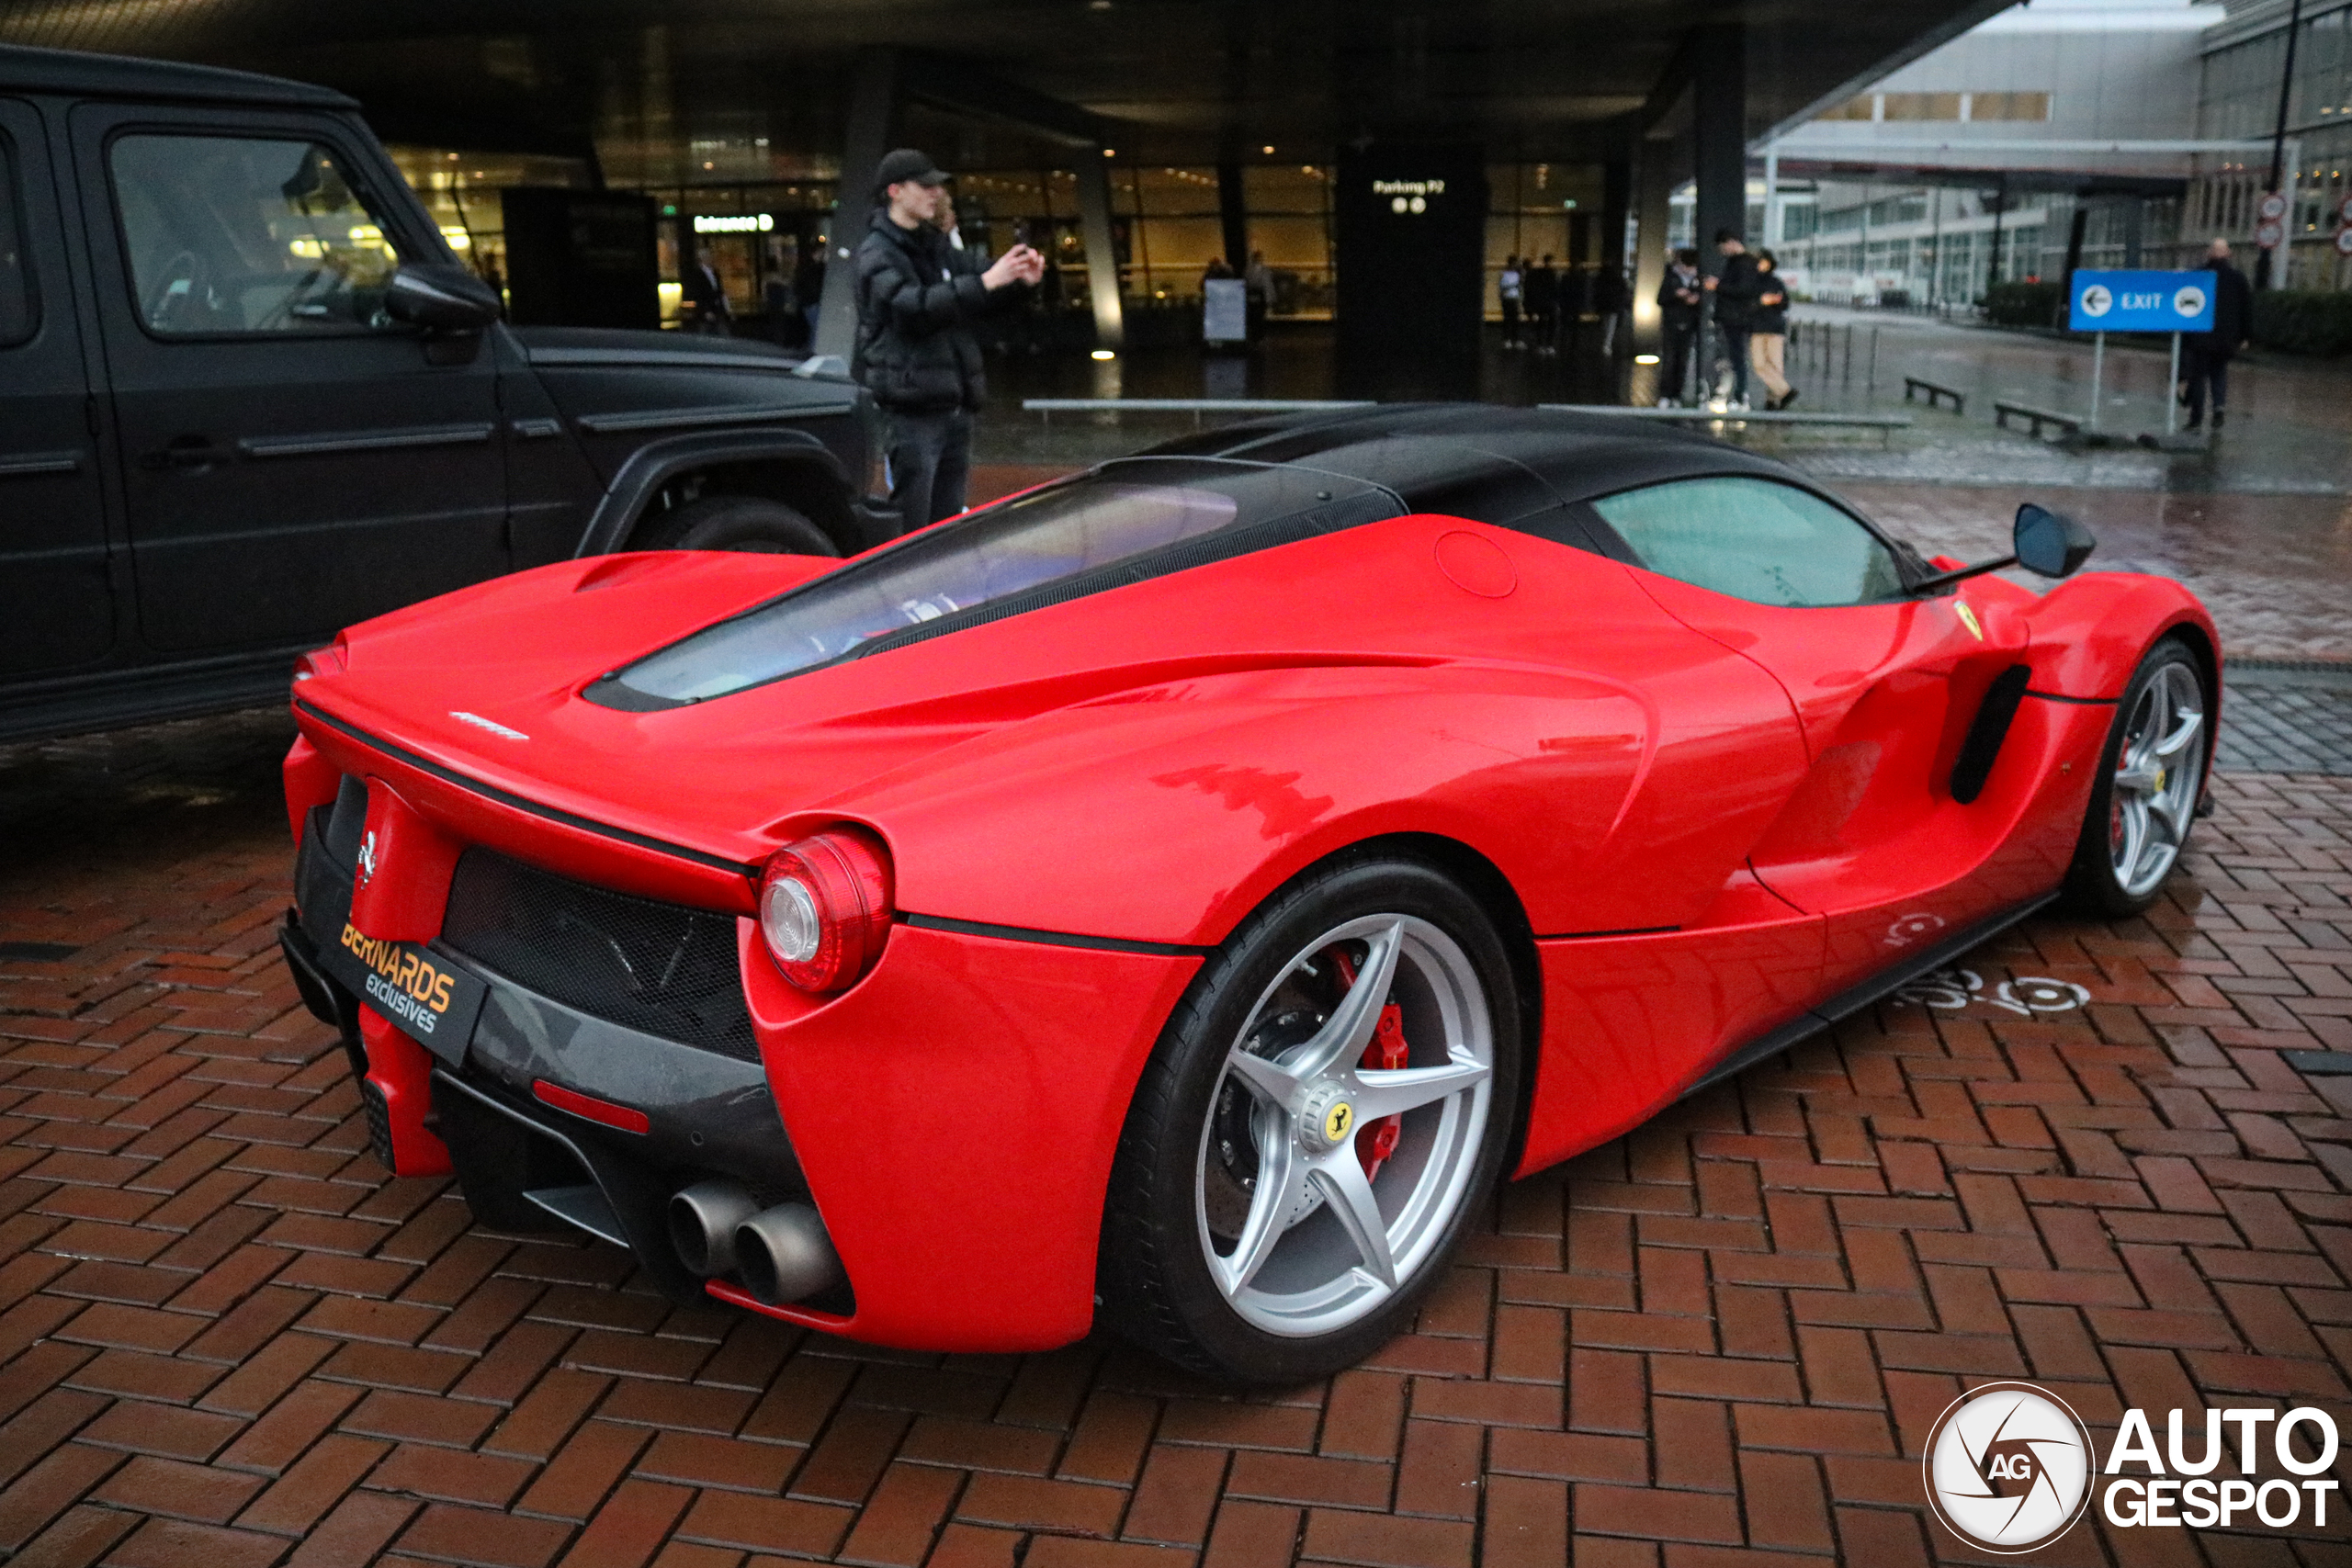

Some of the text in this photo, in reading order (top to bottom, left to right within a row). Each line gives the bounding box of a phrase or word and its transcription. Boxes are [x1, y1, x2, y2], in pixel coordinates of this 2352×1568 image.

[1373, 179, 1426, 196] Parking
[758, 213, 774, 231] D
[2120, 291, 2164, 310] EXIT
[340, 922, 455, 1013] BERNARDS
[365, 973, 437, 1034] exclusives
